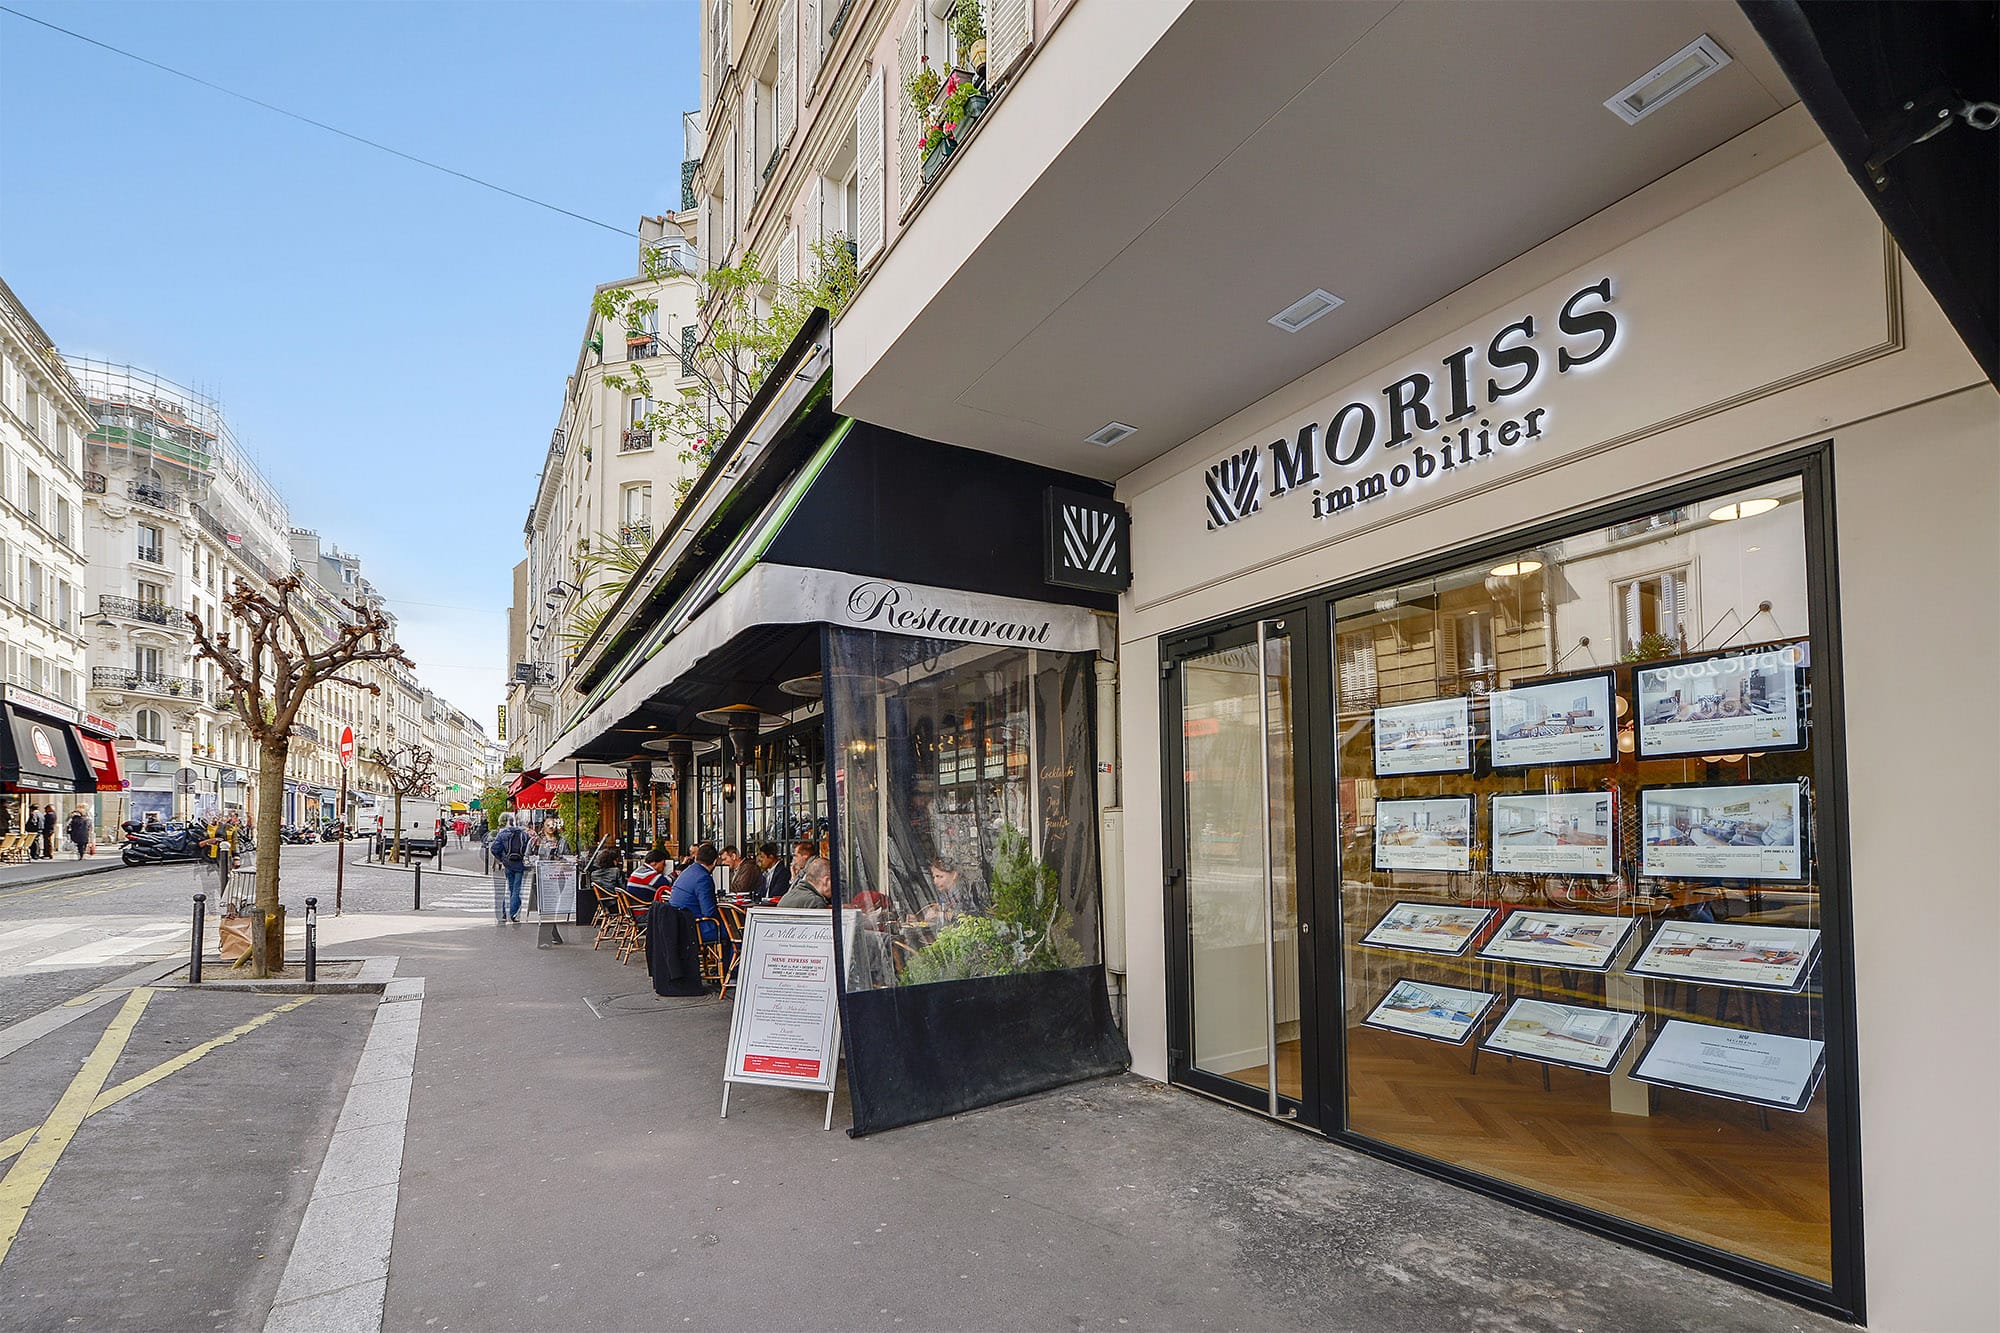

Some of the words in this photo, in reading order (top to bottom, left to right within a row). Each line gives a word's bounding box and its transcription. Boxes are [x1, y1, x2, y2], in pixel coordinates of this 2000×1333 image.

[1268, 277, 1617, 498] MORISS
[1311, 407, 1546, 519] immobilier
[846, 581, 1050, 643] Restaurant
